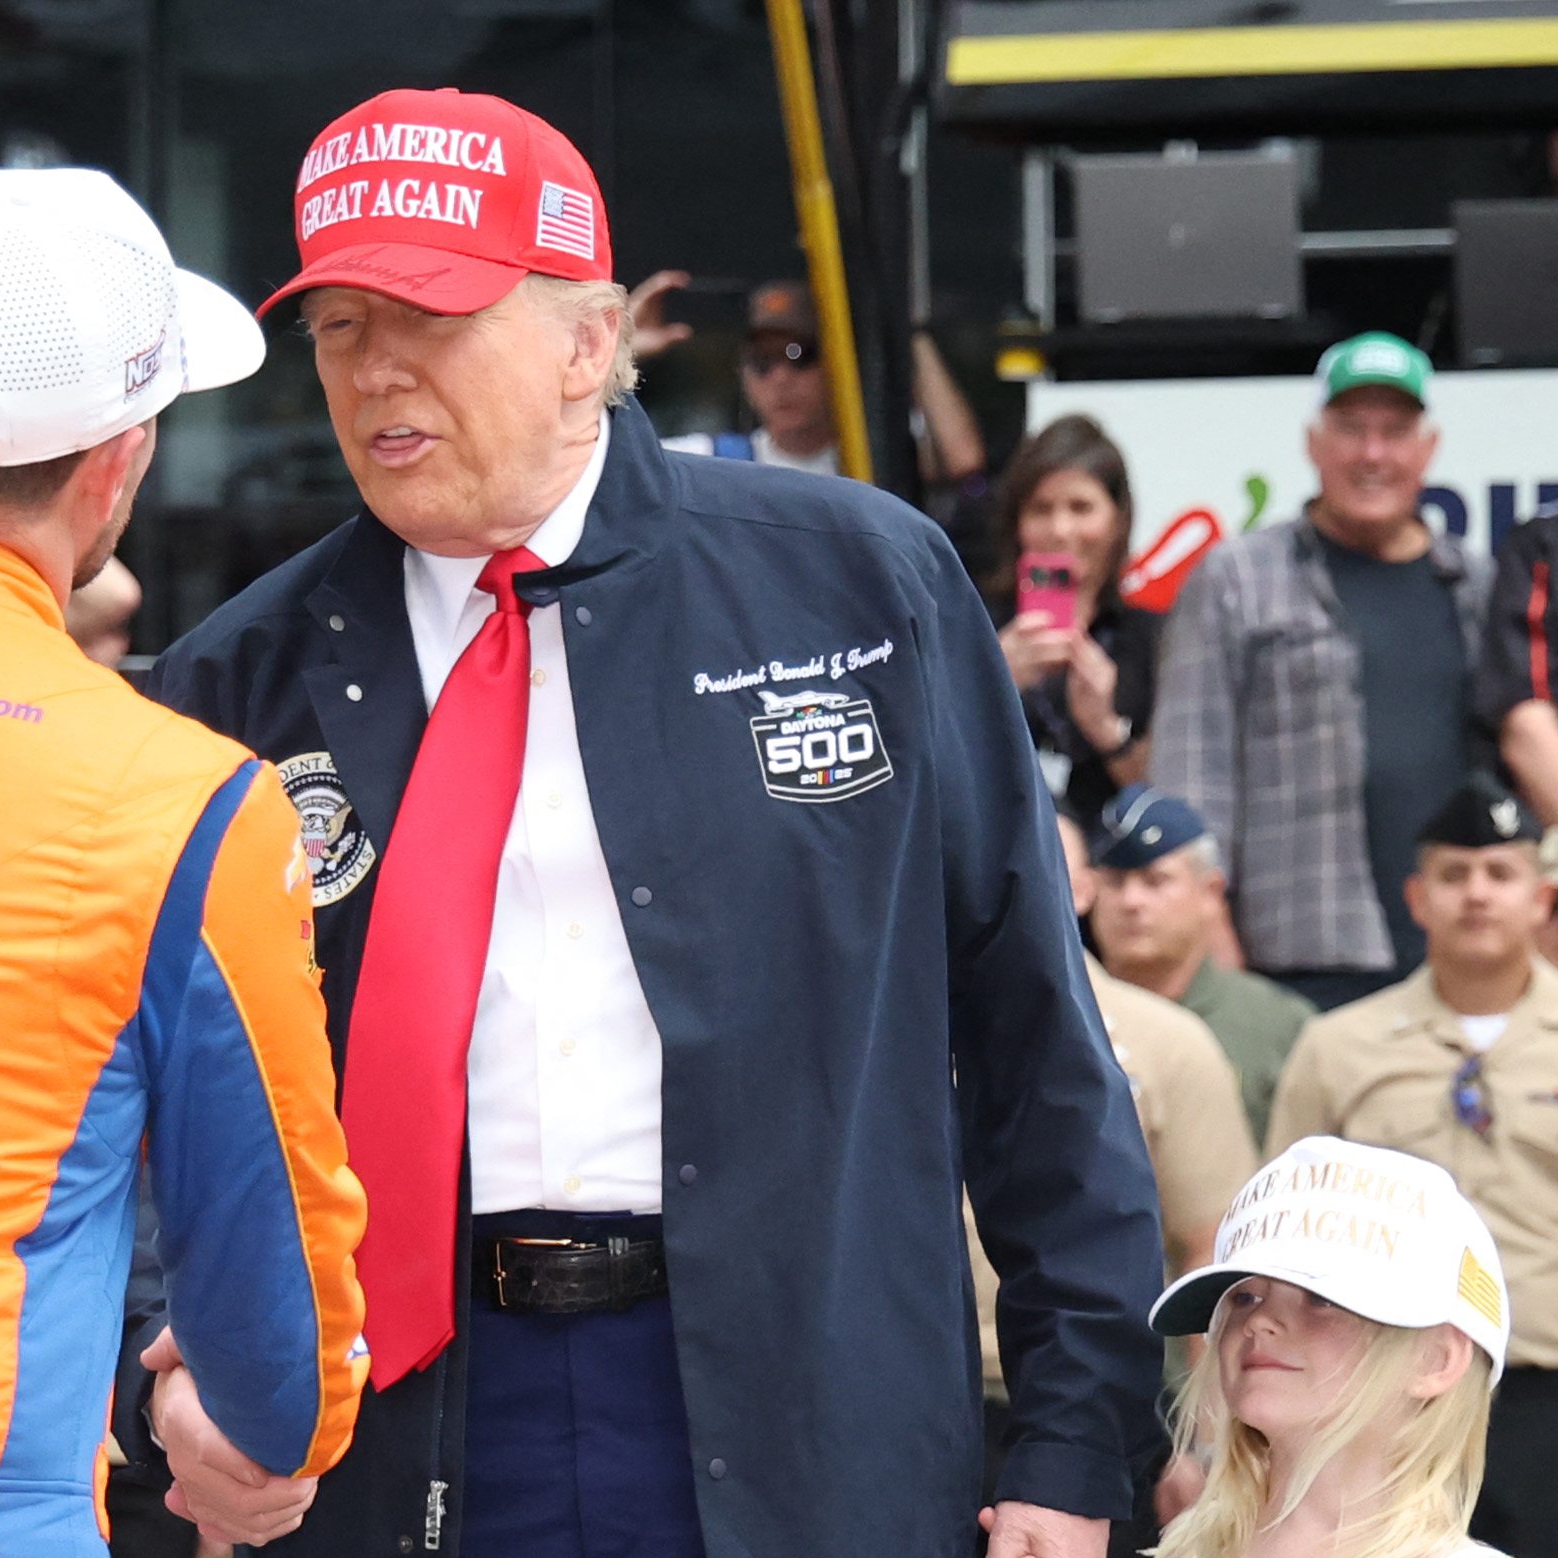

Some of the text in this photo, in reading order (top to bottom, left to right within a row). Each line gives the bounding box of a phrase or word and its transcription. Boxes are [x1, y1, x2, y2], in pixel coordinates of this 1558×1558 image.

[297, 123, 507, 193] MAKE AMERICA
[302, 179, 483, 241] GREAT AGAIN
[694, 665, 766, 695] President
[769, 656, 825, 681] Donald
[847, 638, 893, 670] Trump
[766, 724, 874, 774] 500
[781, 713, 846, 735] DAYTONA
[323, 850, 373, 899] STATES
[1226, 1162, 1427, 1224] MAKE AMERICA
[1222, 1208, 1400, 1263] GREAT AGAIN
